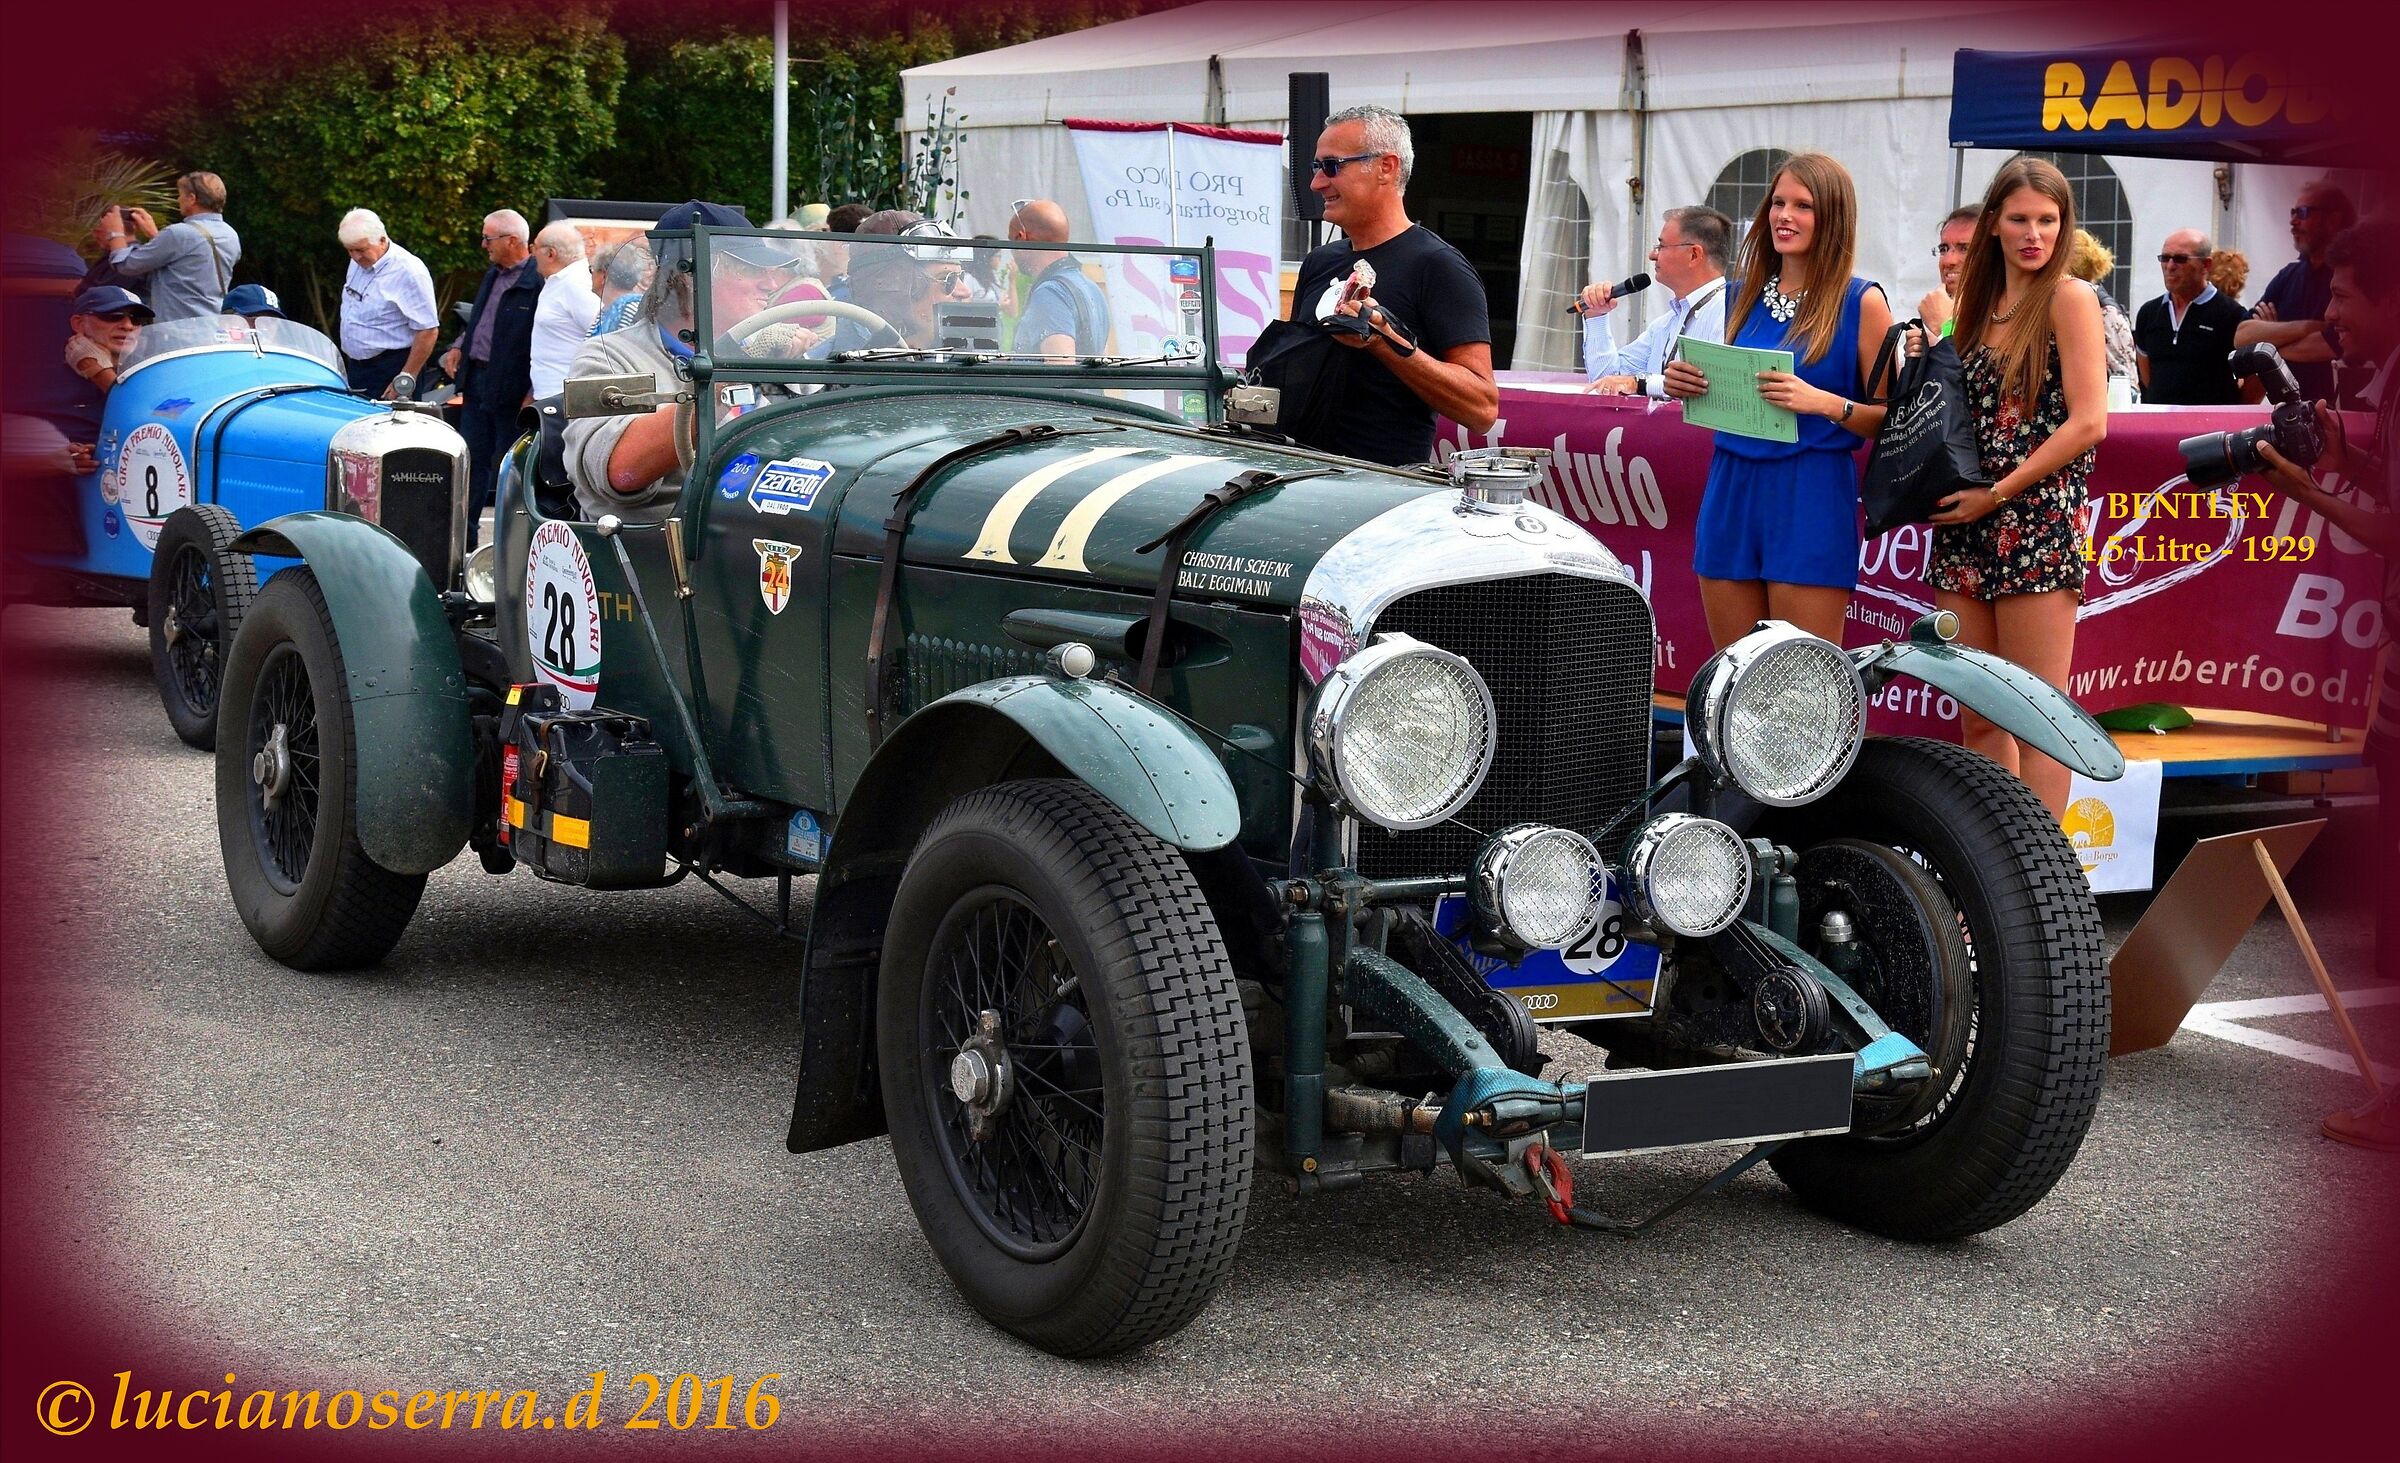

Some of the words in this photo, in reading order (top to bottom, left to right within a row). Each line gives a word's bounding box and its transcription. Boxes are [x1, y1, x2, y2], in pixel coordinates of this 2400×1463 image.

[120, 447, 132, 487] GRAN
[130, 425, 162, 447] PREMIO
[162, 432, 186, 499] NUVOLARI
[731, 462, 751, 475] 2015
[145, 465, 159, 517] 8
[758, 472, 823, 495] zanetti
[764, 561, 790, 597] 24
[1182, 551, 1243, 574] CHRISTIAN
[1244, 558, 1293, 578] SCHENK
[526, 545, 537, 609] GRAN
[536, 523, 570, 552] PREMIO
[571, 541, 599, 654] NUVOLARI
[1178, 570, 1206, 589] BALZ
[1209, 575, 1272, 597] EGGIMANN
[543, 581, 576, 677] 28
[1860, 604, 1905, 640] tartufo)
[2093, 851, 2119, 863] Borgo
[1563, 914, 1626, 961] 28
